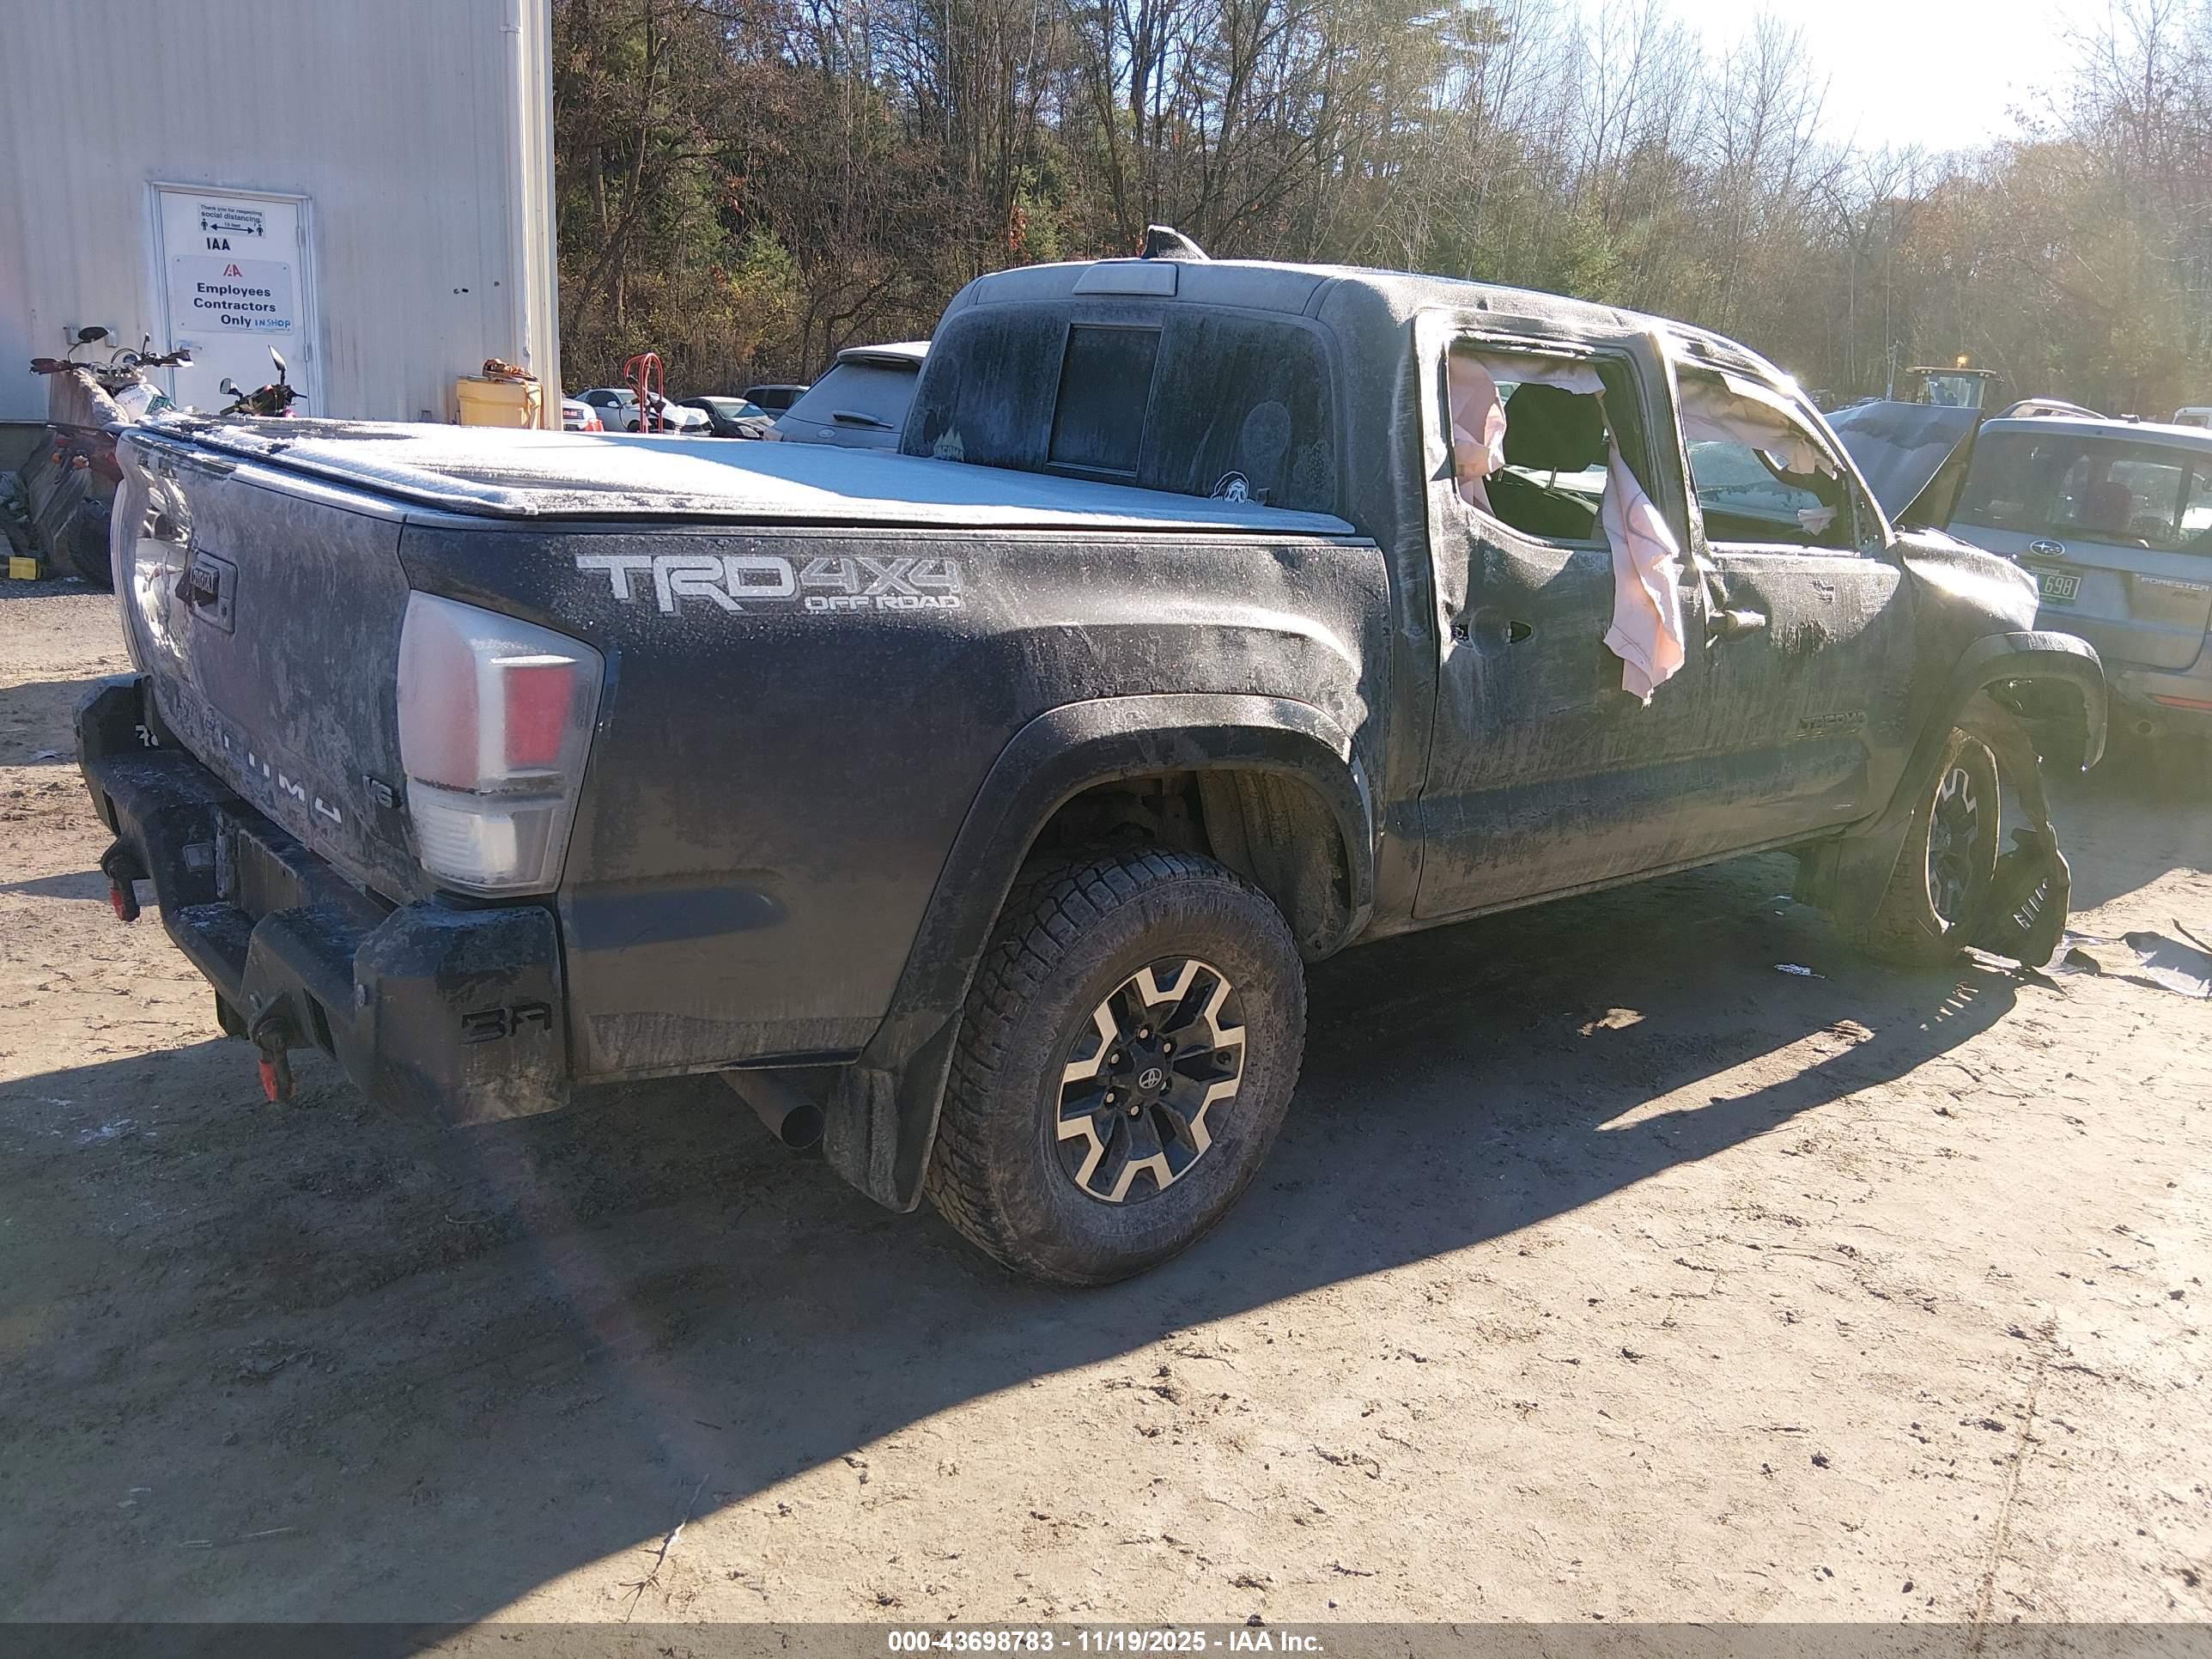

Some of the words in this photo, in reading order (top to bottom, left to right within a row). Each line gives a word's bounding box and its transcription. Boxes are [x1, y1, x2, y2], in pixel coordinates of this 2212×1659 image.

[223, 214, 262, 223] distancing.
[206, 237, 231, 251] IAA
[197, 282, 271, 297] Employees
[193, 297, 276, 313] Contractors
[221, 314, 252, 328] Only
[575, 555, 799, 613] TRD
[2045, 575, 2074, 596] 698
[804, 596, 870, 611] OFF
[874, 596, 962, 611] ROAD
